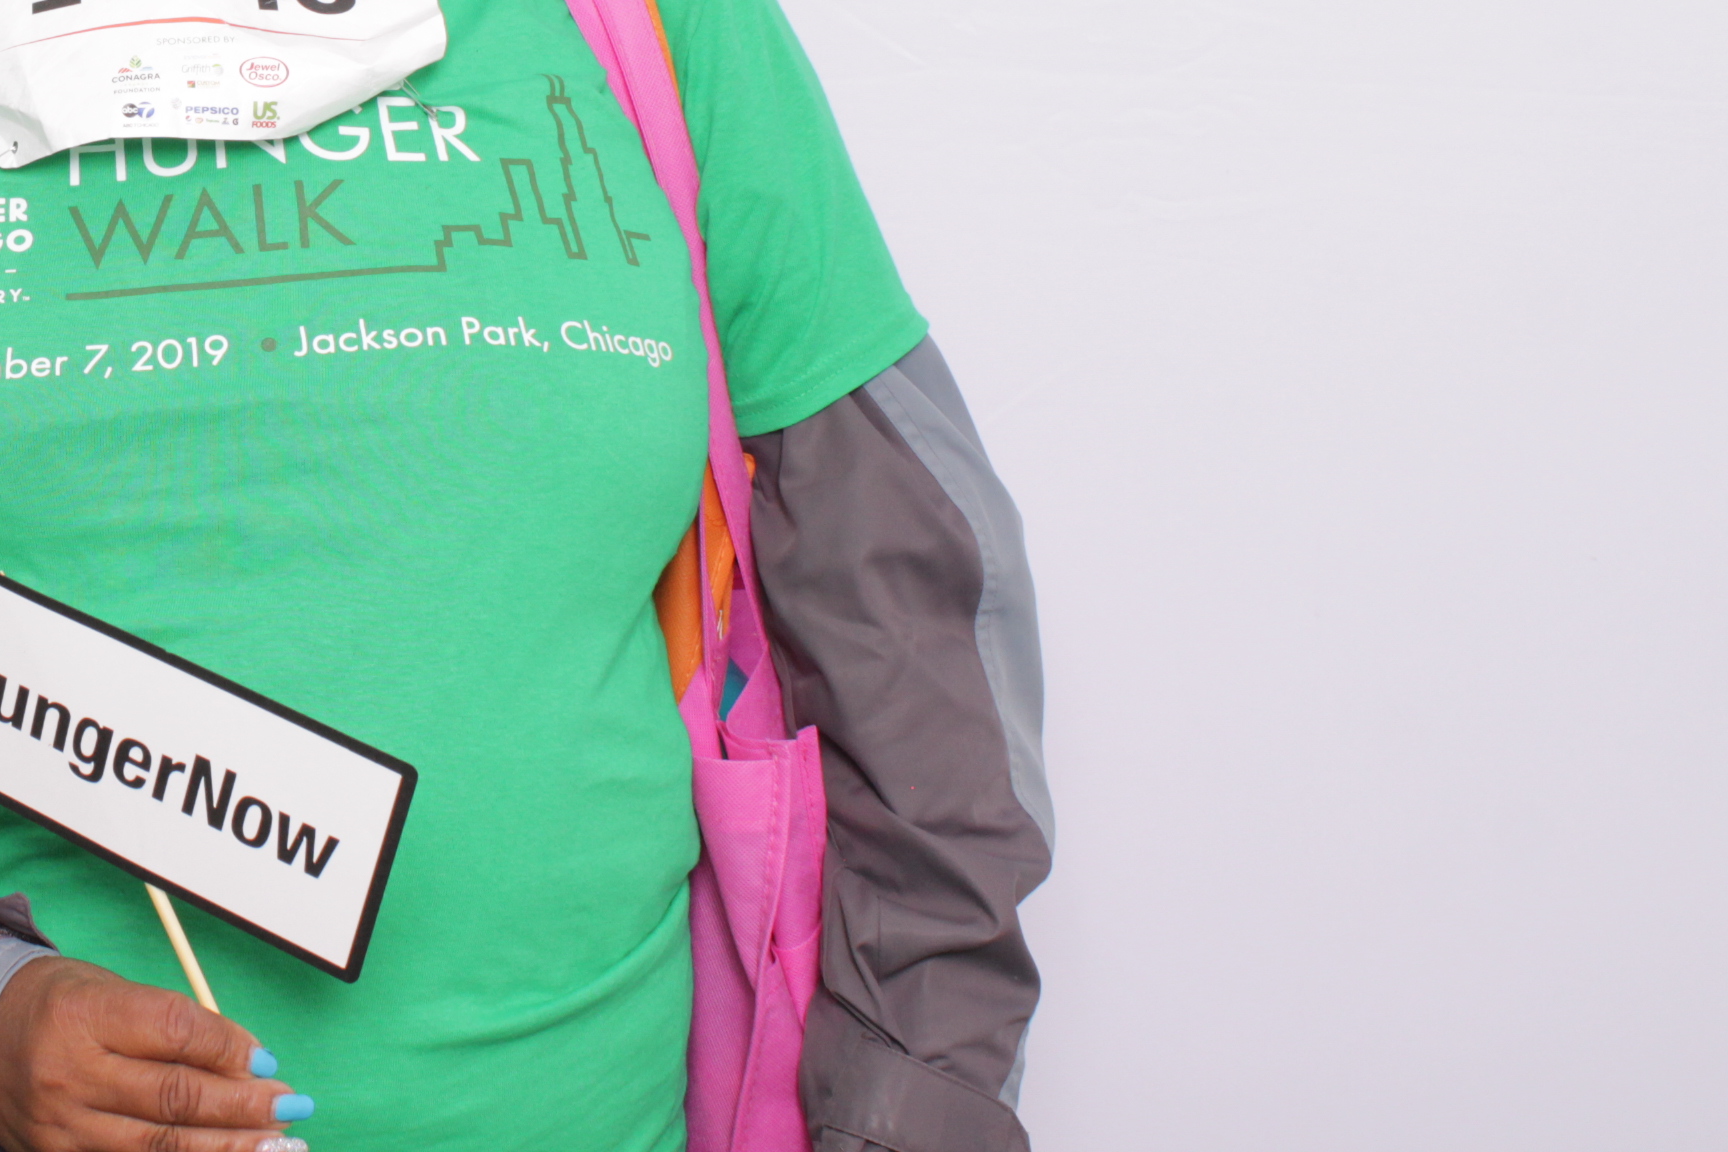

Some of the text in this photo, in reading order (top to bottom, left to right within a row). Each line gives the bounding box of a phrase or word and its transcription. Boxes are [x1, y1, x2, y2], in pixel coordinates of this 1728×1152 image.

[156, 35, 220, 46] SPONSORED
[181, 64, 211, 76] Griffith
[246, 62, 280, 71] Jewel
[112, 73, 161, 83] CONAGRA
[122, 106, 138, 114] abc
[185, 106, 239, 116] PEPSICO
[67, 178, 357, 270] WALK
[81, 343, 113, 380] 7,
[132, 333, 229, 374] 2019
[293, 320, 448, 358] Jackson
[462, 316, 550, 352] Park,
[560, 320, 674, 368] Chicago
